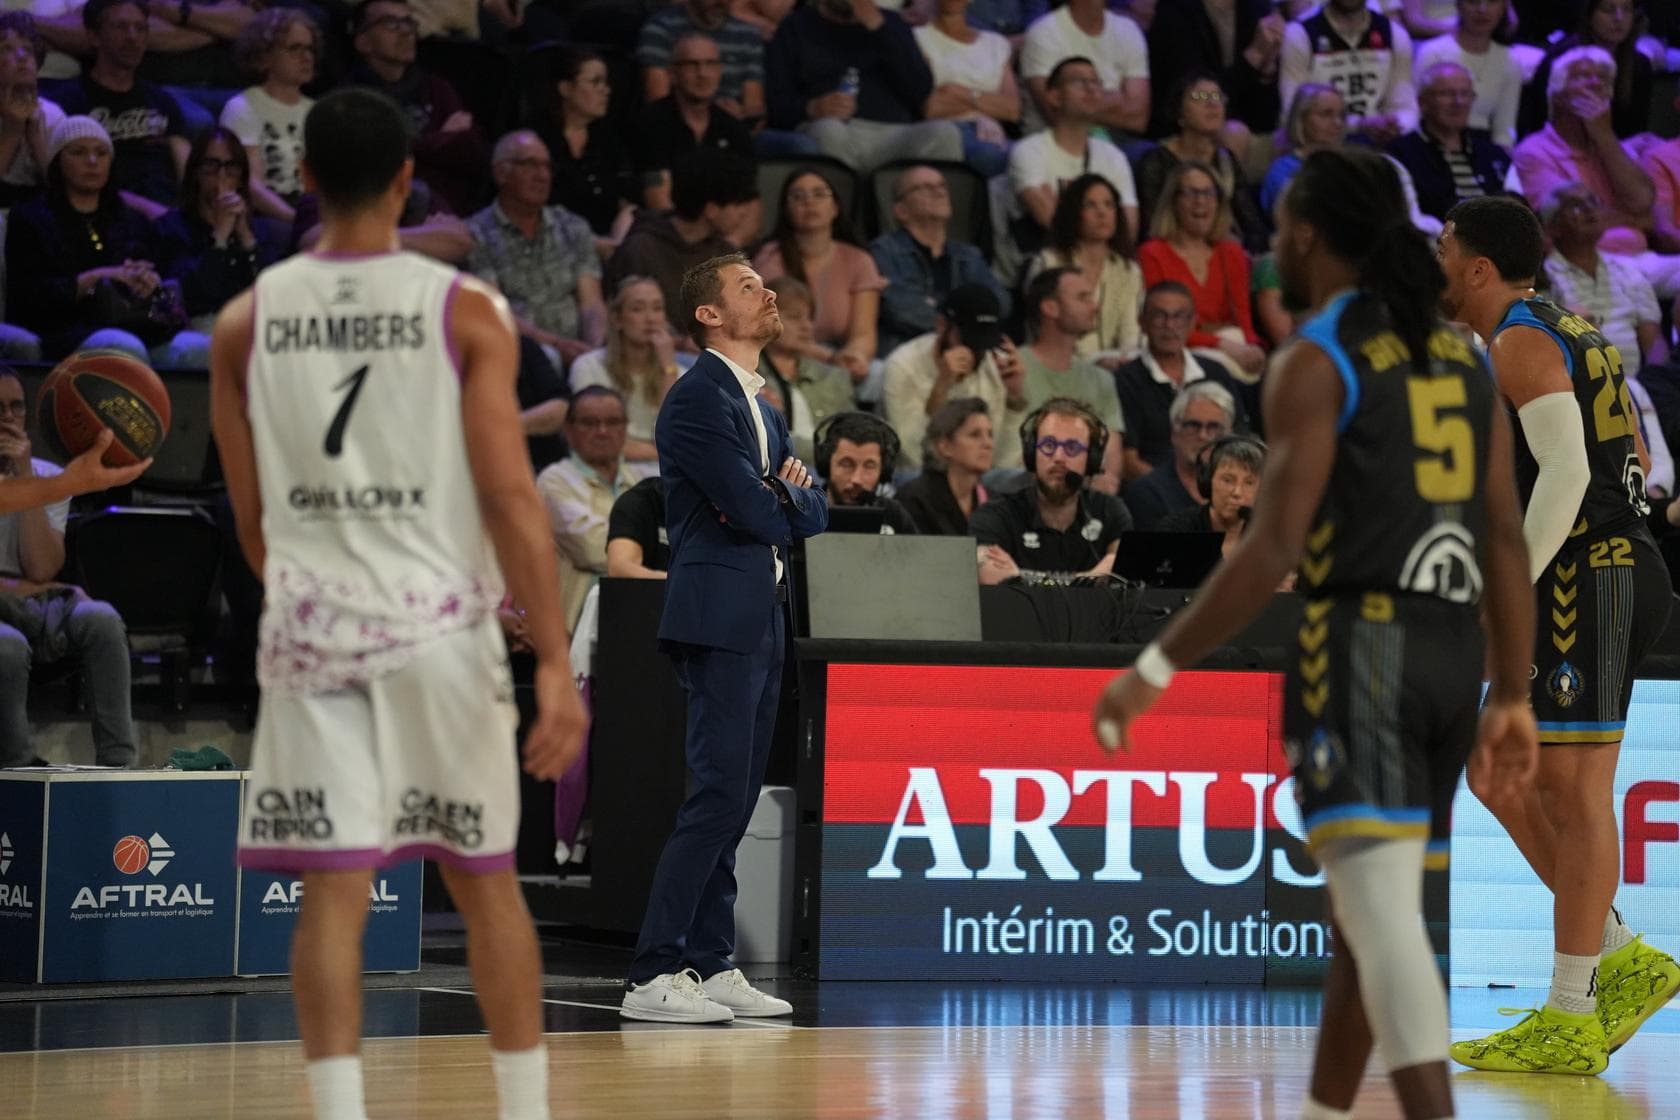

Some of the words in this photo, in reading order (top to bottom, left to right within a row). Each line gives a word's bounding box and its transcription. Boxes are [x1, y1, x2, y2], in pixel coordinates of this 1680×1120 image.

[265, 314, 426, 353] CHAMBERS
[323, 363, 371, 459] 1
[1586, 345, 1635, 442] 22
[1406, 374, 1474, 503] 5
[1589, 537, 1635, 568] 22
[867, 766, 1327, 887] ARTUS
[70, 882, 215, 909] AFTRAL
[70, 909, 104, 921] Apprendre
[119, 908, 140, 919] former
[150, 908, 177, 919] transport
[185, 906, 214, 919] logistique
[262, 879, 399, 903] AFAL
[943, 904, 1095, 954] Intérim
[1106, 914, 1135, 956] &
